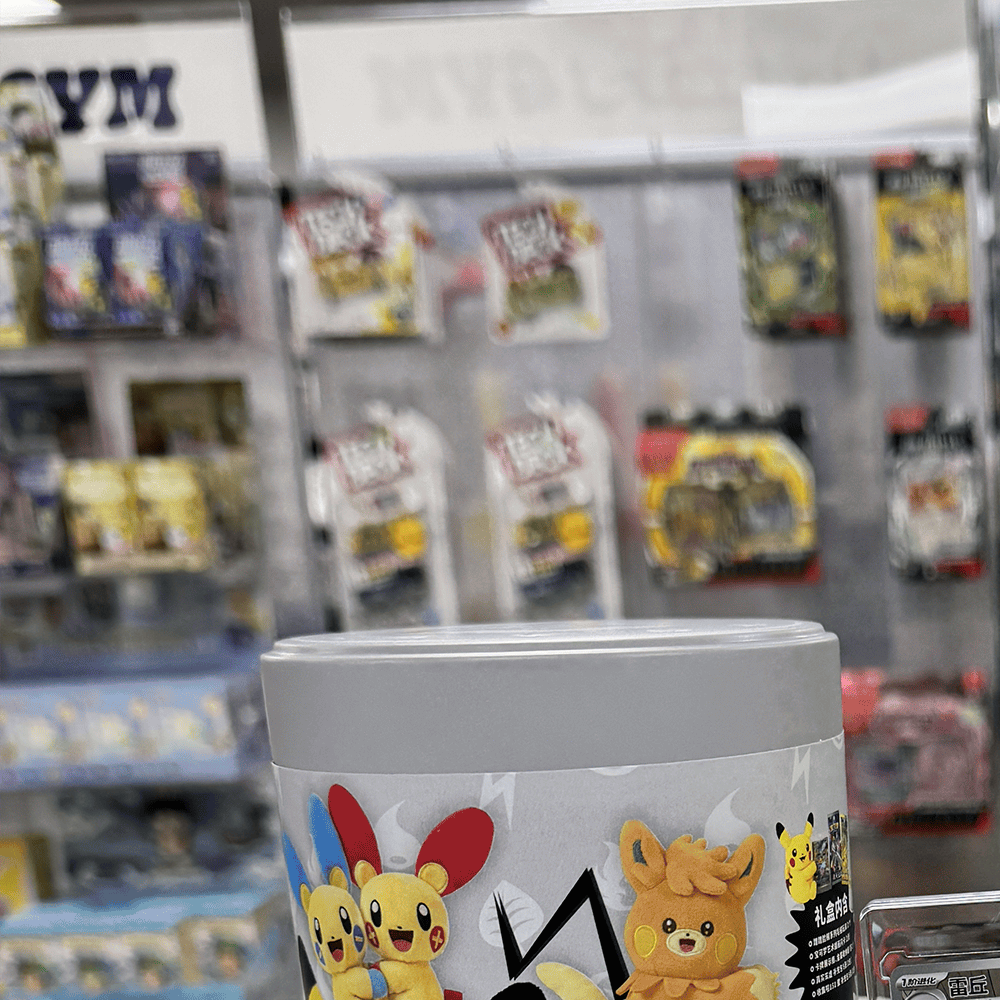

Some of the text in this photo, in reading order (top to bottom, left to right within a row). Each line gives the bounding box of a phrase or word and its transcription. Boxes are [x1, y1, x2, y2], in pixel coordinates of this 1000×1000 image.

[1, 69, 177, 132] YM
[814, 892, 848, 928] 礼盒内含
[949, 976, 989, 997] 雷丘
